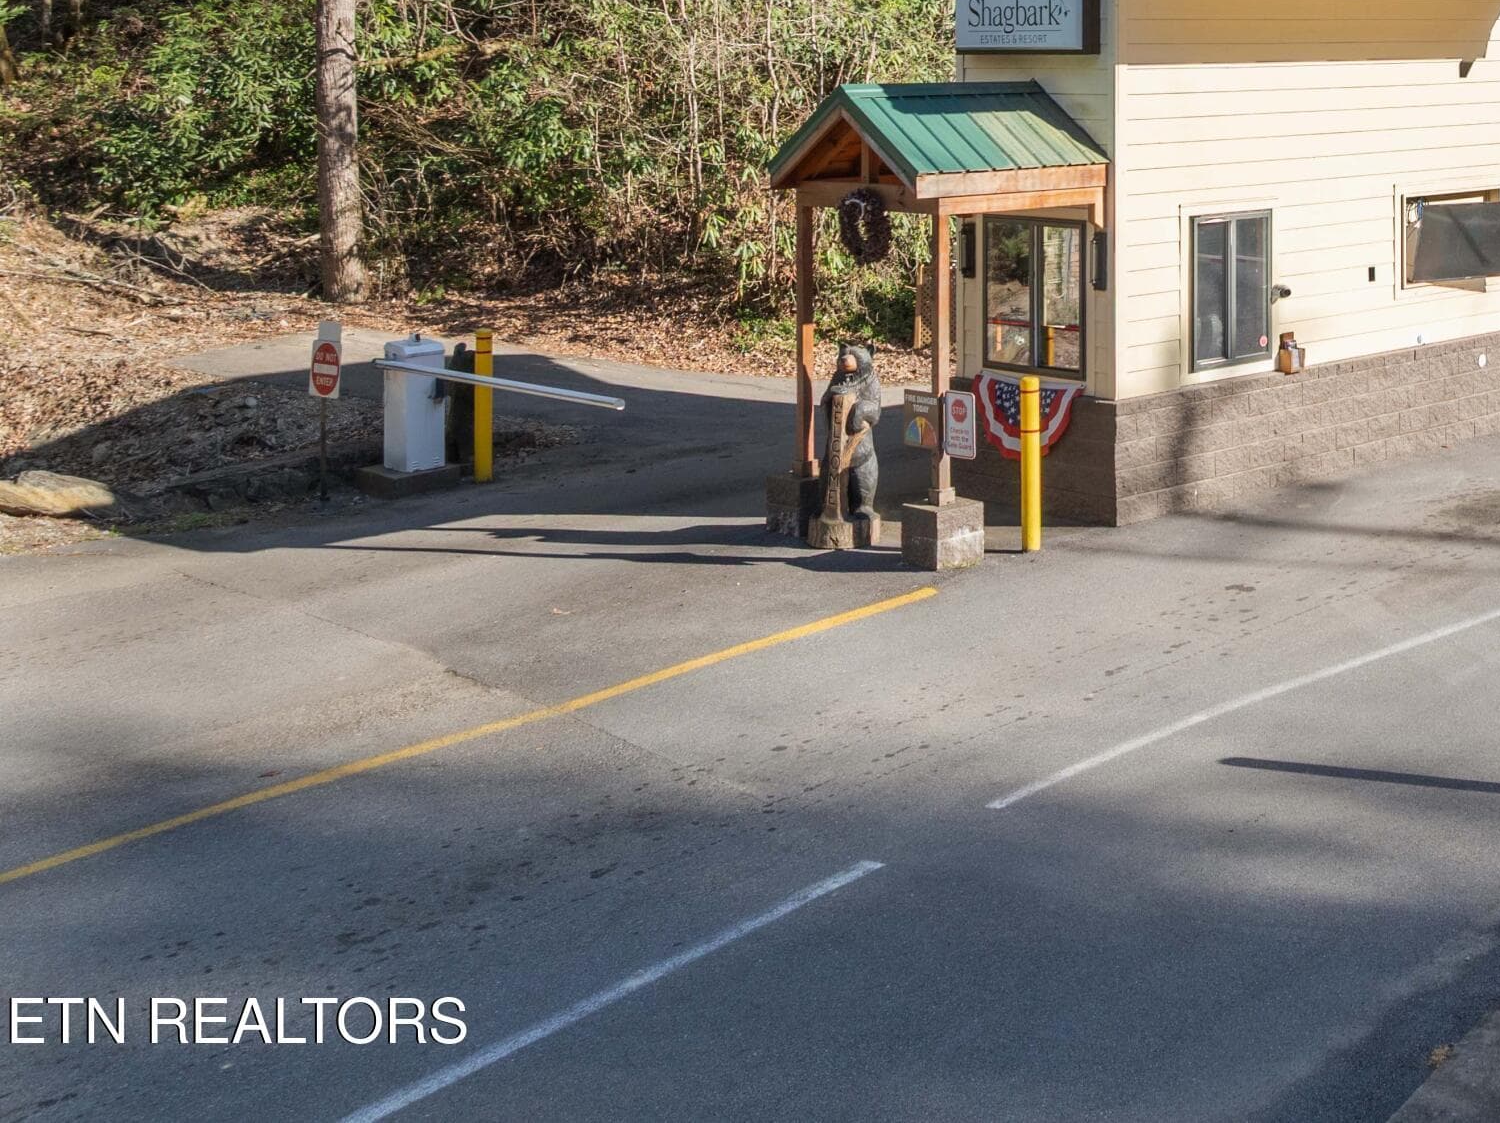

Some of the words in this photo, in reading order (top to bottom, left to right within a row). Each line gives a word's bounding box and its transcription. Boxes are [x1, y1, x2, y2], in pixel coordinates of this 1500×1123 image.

[980, 35, 1011, 45] ESTATES
[1018, 34, 1047, 44] RESORT
[315, 351, 324, 361] DO
[325, 352, 337, 364] NOT
[316, 376, 333, 386] ENTER
[951, 406, 967, 415] STOP
[828, 399, 843, 505] WELCOME
